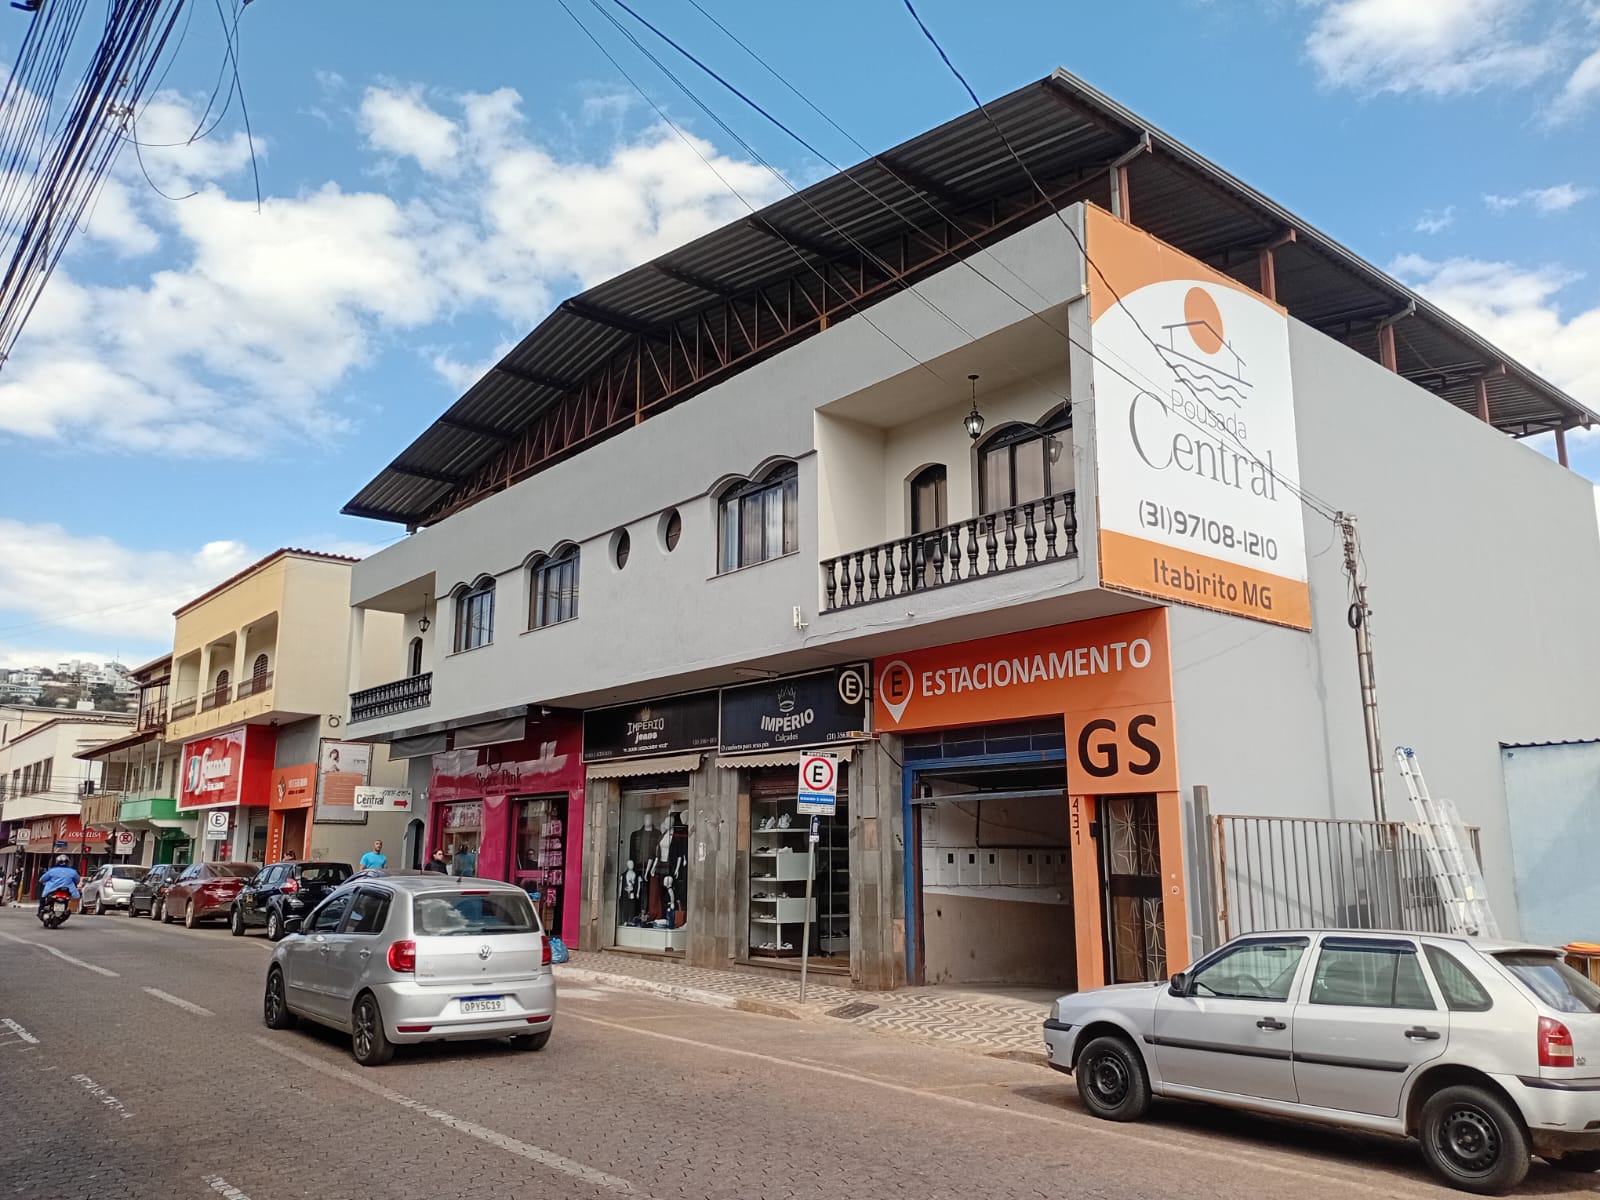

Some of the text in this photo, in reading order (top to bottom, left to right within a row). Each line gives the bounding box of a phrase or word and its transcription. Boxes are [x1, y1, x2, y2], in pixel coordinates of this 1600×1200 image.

[1170, 389, 1247, 440] Pousada
[1129, 391, 1278, 501] Central
[1138, 499, 1278, 561] (31)97108-1210
[1153, 557, 1272, 610] Itabirito MG
[892, 638, 1151, 697] E ESTACIONAMENTO
[846, 677, 857, 697] E
[760, 708, 815, 732] IMPÉRIO
[775, 732, 799, 743] Calçados
[1077, 714, 1161, 778] GS
[502, 767, 522, 785] Pink
[813, 765, 823, 783] E
[356, 794, 384, 806] Central
[215, 815, 222, 825] E
